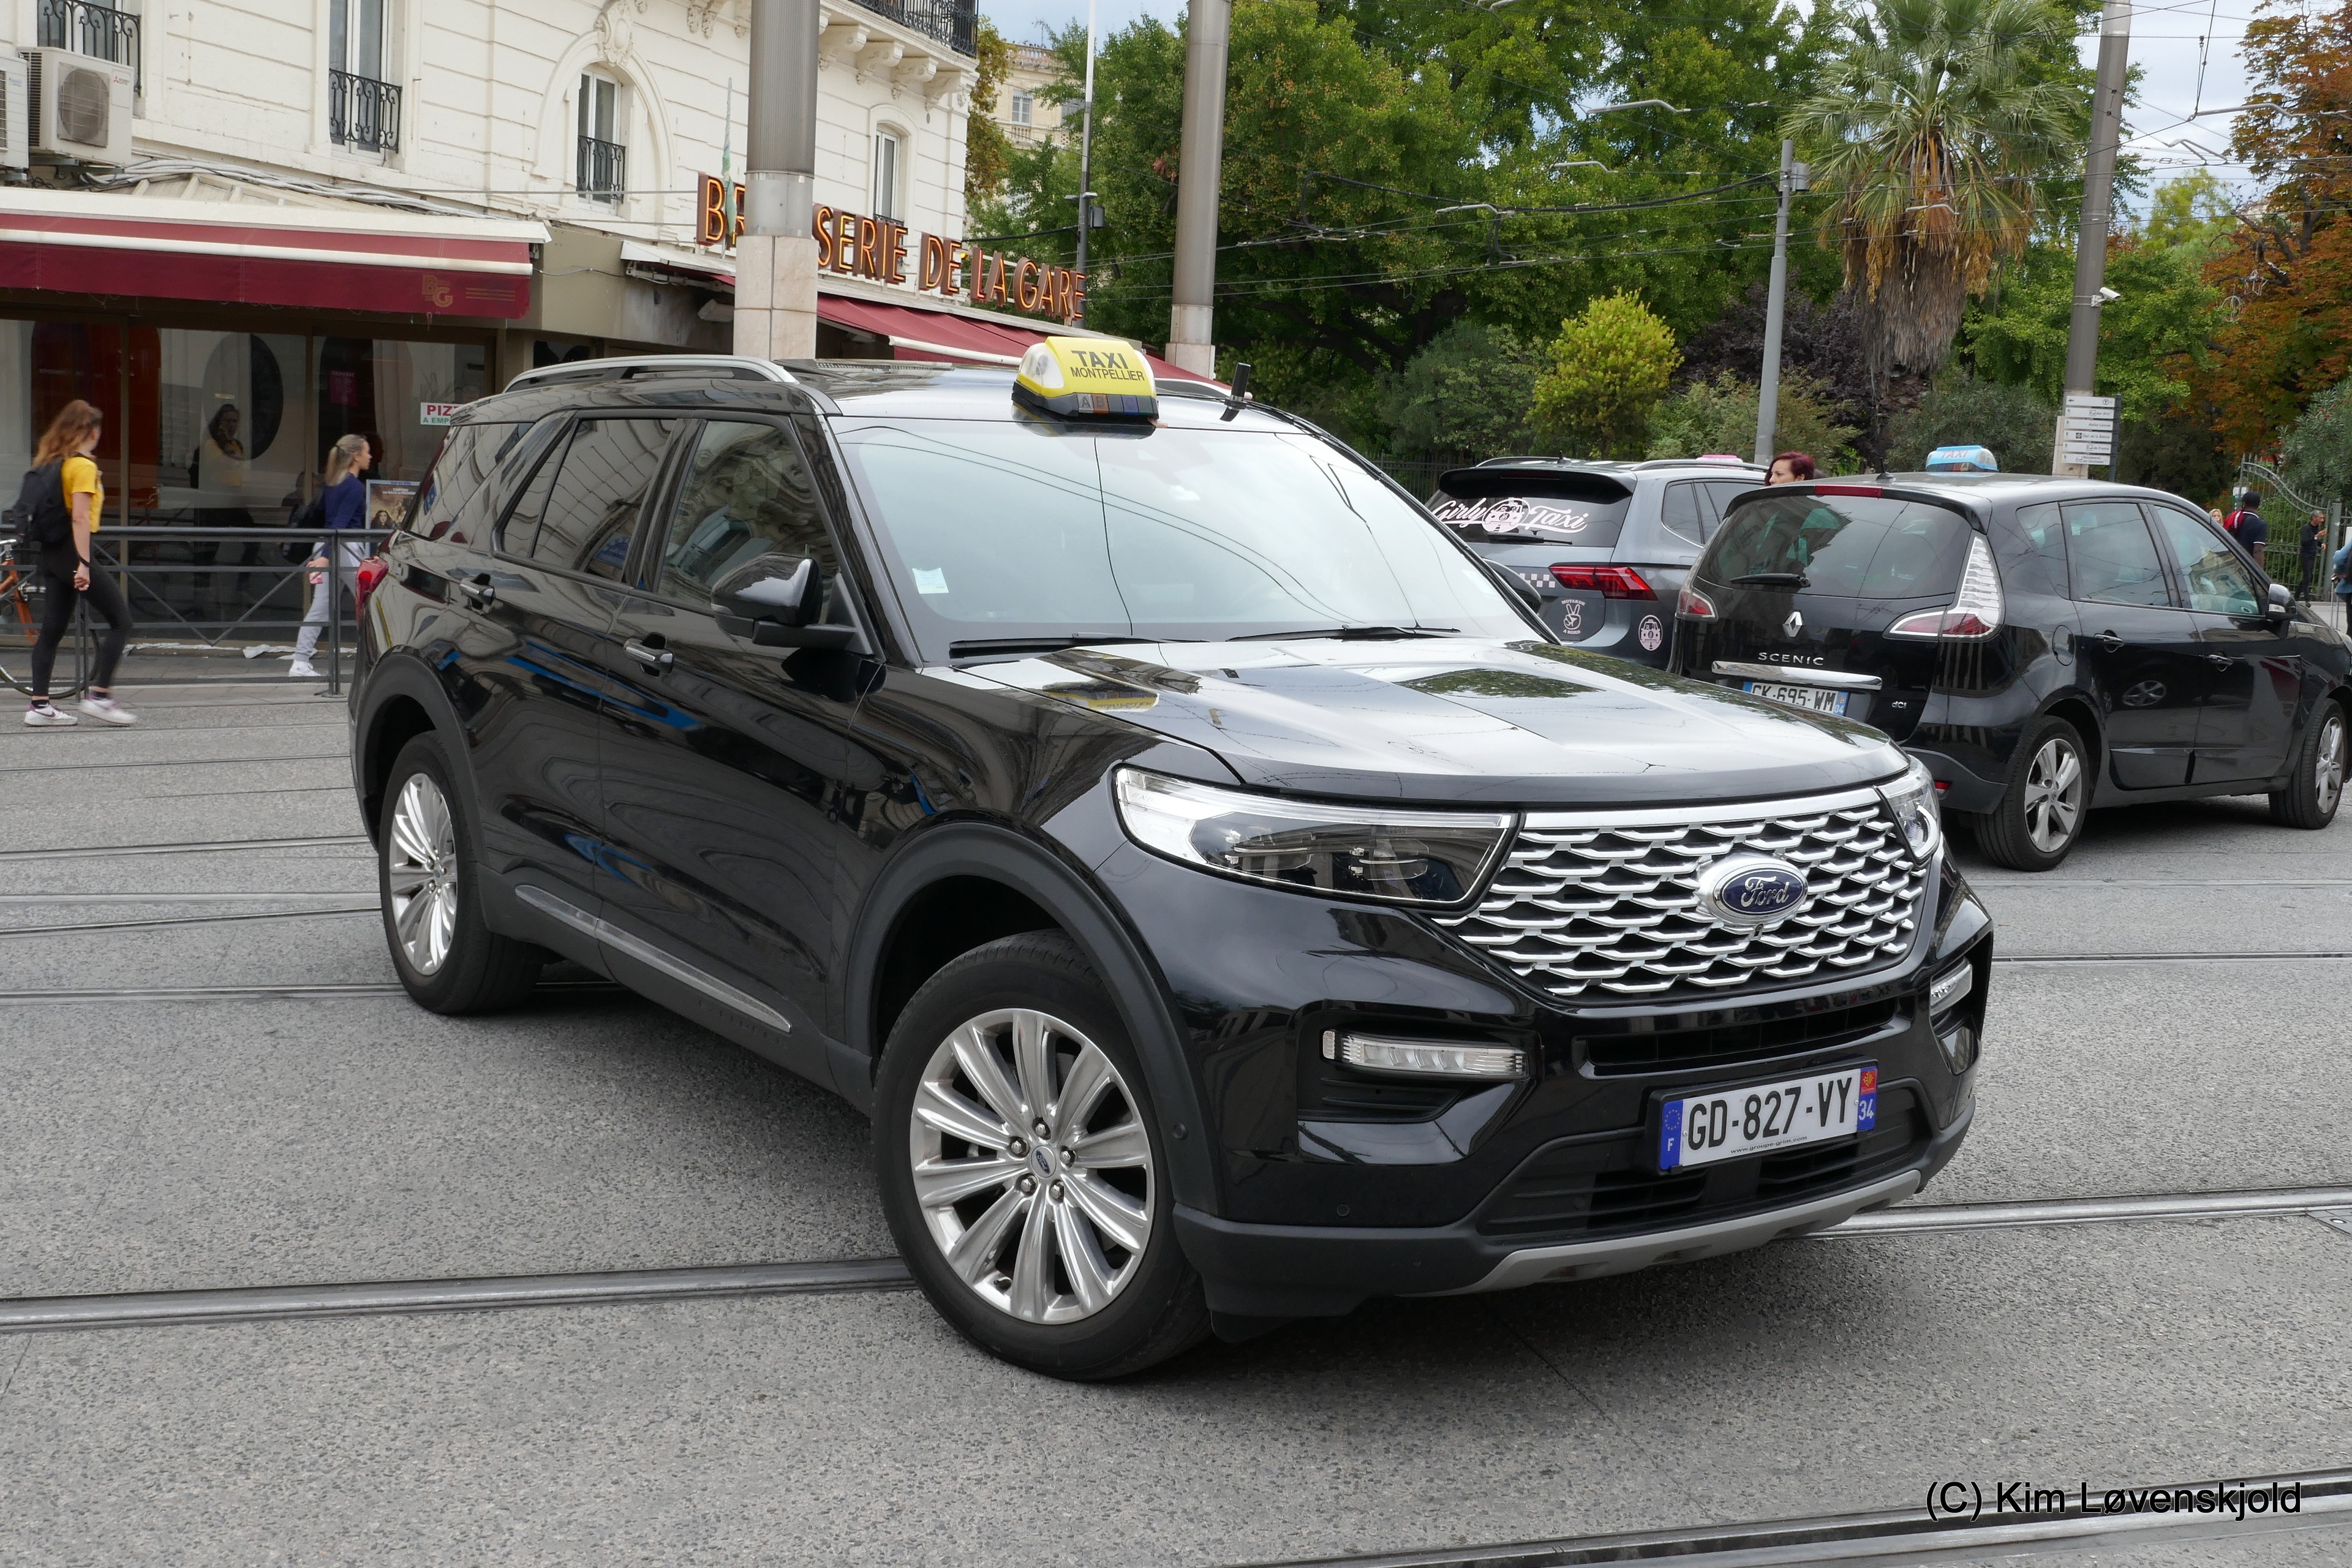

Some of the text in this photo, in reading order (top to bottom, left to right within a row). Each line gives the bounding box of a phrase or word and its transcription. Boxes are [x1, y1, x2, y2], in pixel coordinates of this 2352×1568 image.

[697, 173, 1085, 321] BSERIE DE LA GARE
[1070, 350, 1145, 381] TAXI MONTPELLIER
[427, 405, 459, 416] PIZ
[1942, 450, 1969, 459] TAXI
[1432, 497, 1589, 533] Girly Taxi
[1758, 652, 1824, 666] SCENIC
[1834, 704, 1844, 714] 04
[1741, 876, 1789, 907] Ford
[1688, 1077, 1852, 1150] GD-827-VY
[1858, 1098, 1874, 1120] 34
[1667, 1137, 1674, 1152] F
[1730, 1136, 1807, 1153] www.groupe-grim.com
